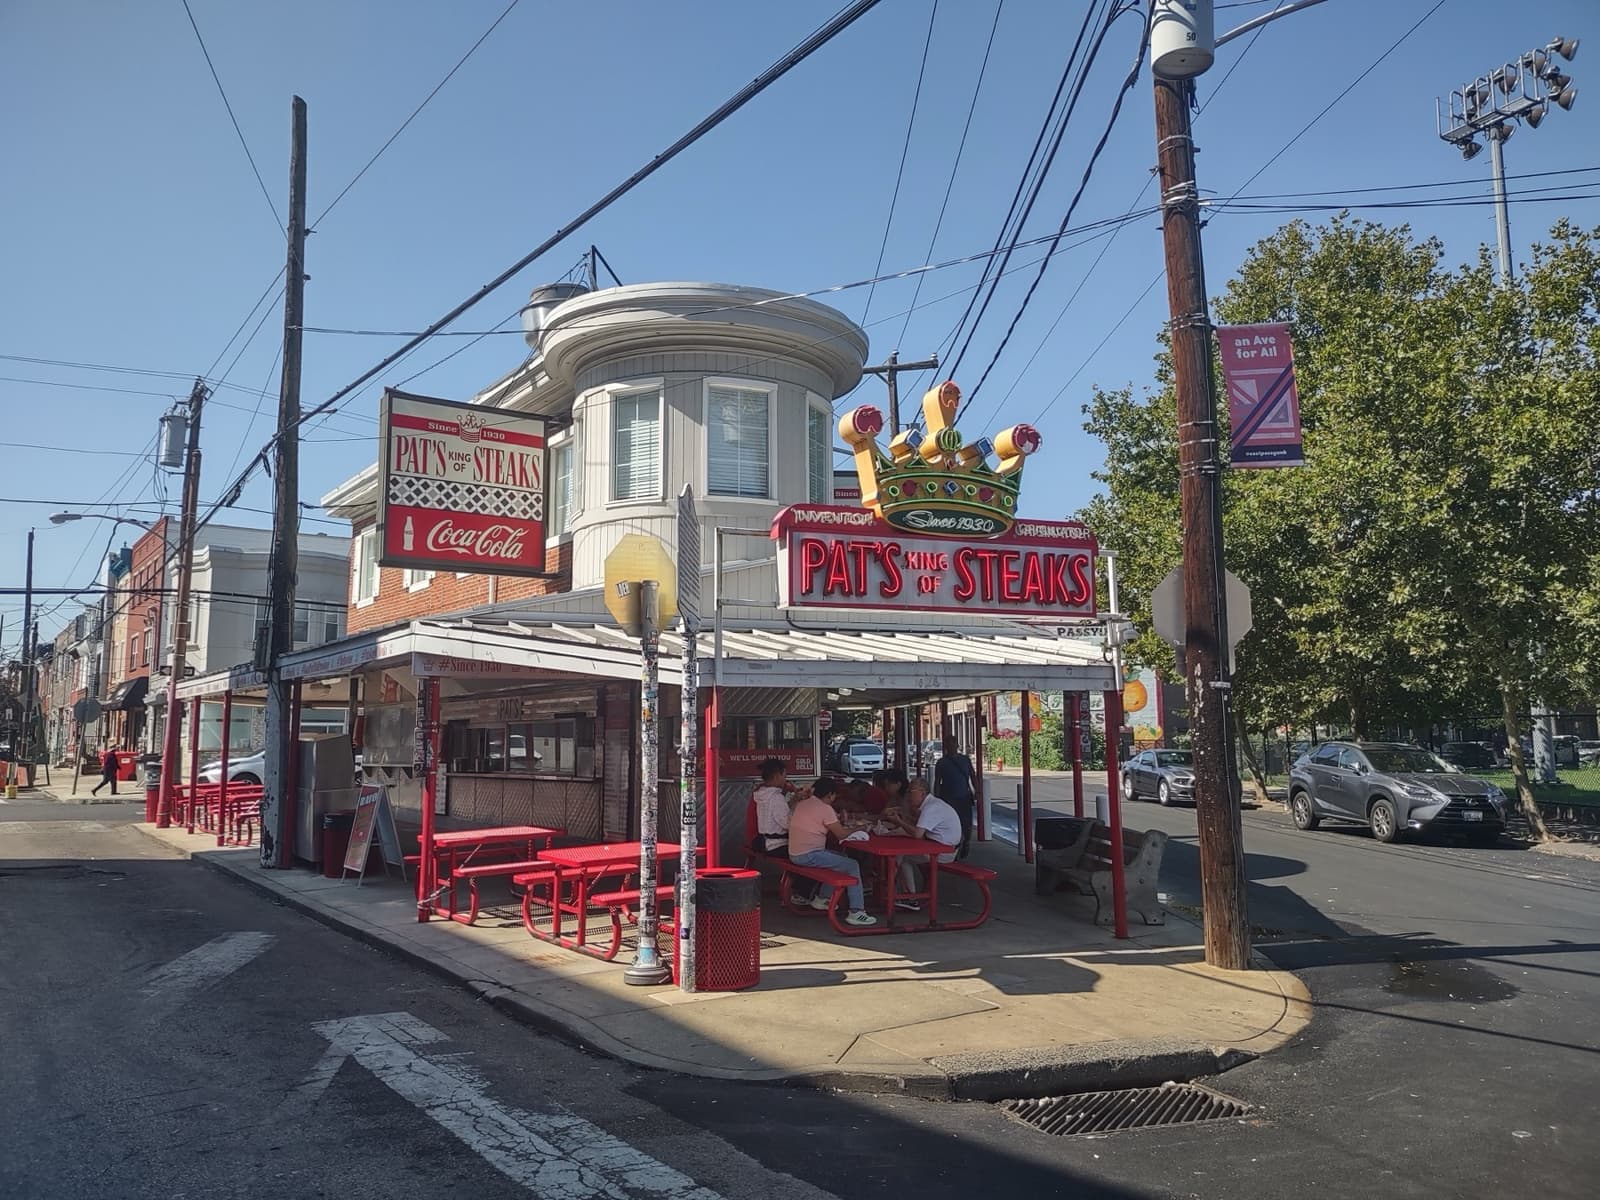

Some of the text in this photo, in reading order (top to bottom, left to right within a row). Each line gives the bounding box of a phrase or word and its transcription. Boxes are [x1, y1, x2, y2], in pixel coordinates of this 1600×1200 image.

[1185, 32, 1197, 41] 50
[1234, 335, 1276, 347] an Ave
[1236, 345, 1278, 359] for All
[428, 421, 506, 440] Since 1930
[395, 434, 541, 490] PAT'S KING OF STEAKS
[904, 510, 994, 533] Since 1930
[426, 519, 529, 560] Coca-Cola
[801, 538, 1091, 607] PAT'S KING OF STEAKS
